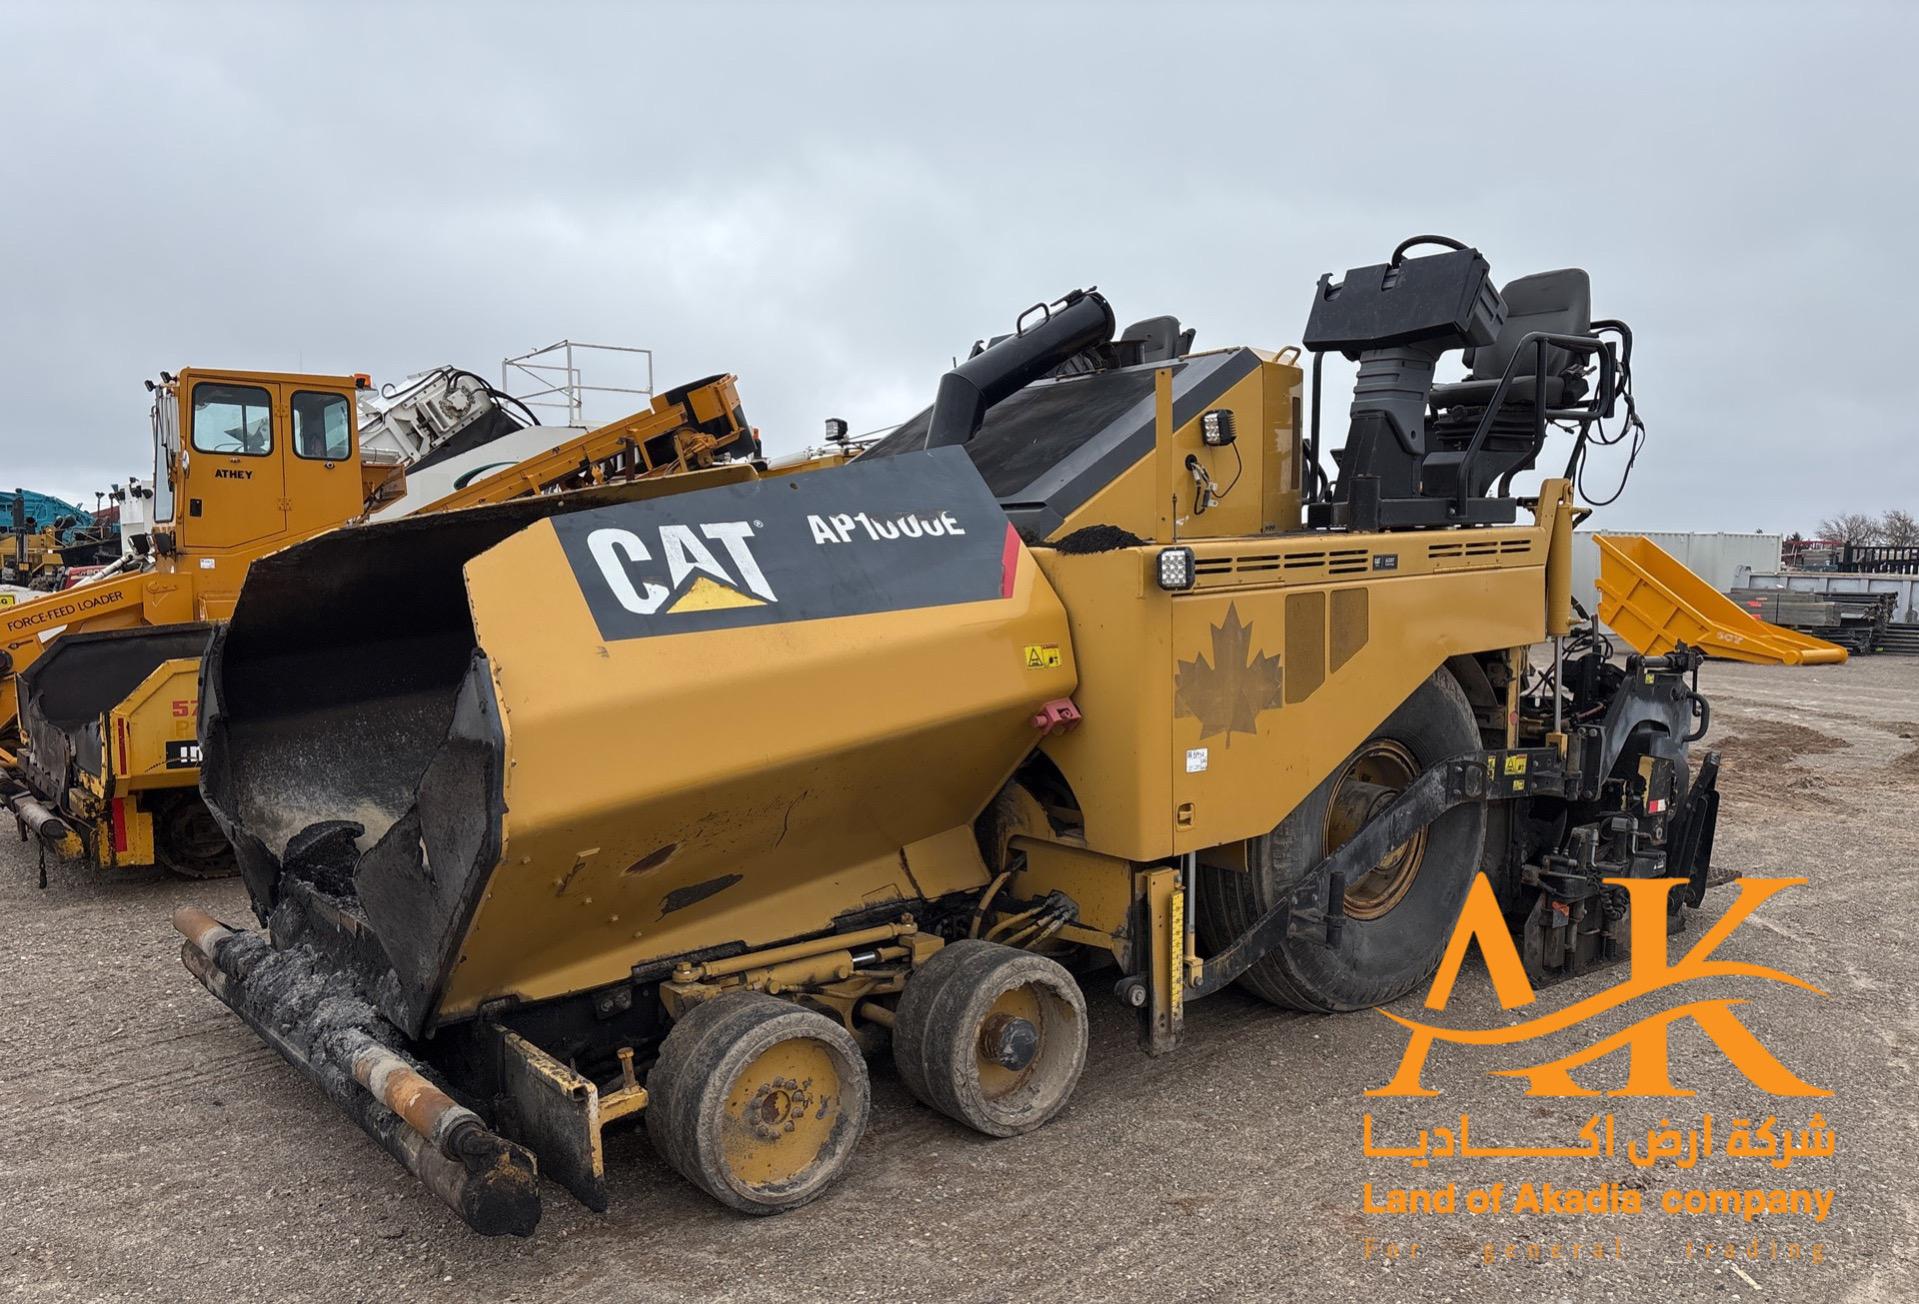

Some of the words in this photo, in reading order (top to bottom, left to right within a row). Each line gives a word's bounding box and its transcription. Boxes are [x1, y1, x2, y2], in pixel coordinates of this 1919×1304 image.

[215, 468, 253, 480] ATHEY
[586, 520, 779, 616] CAT
[7, 604, 76, 632] FORCE-FEED
[77, 590, 124, 611] LOADER
